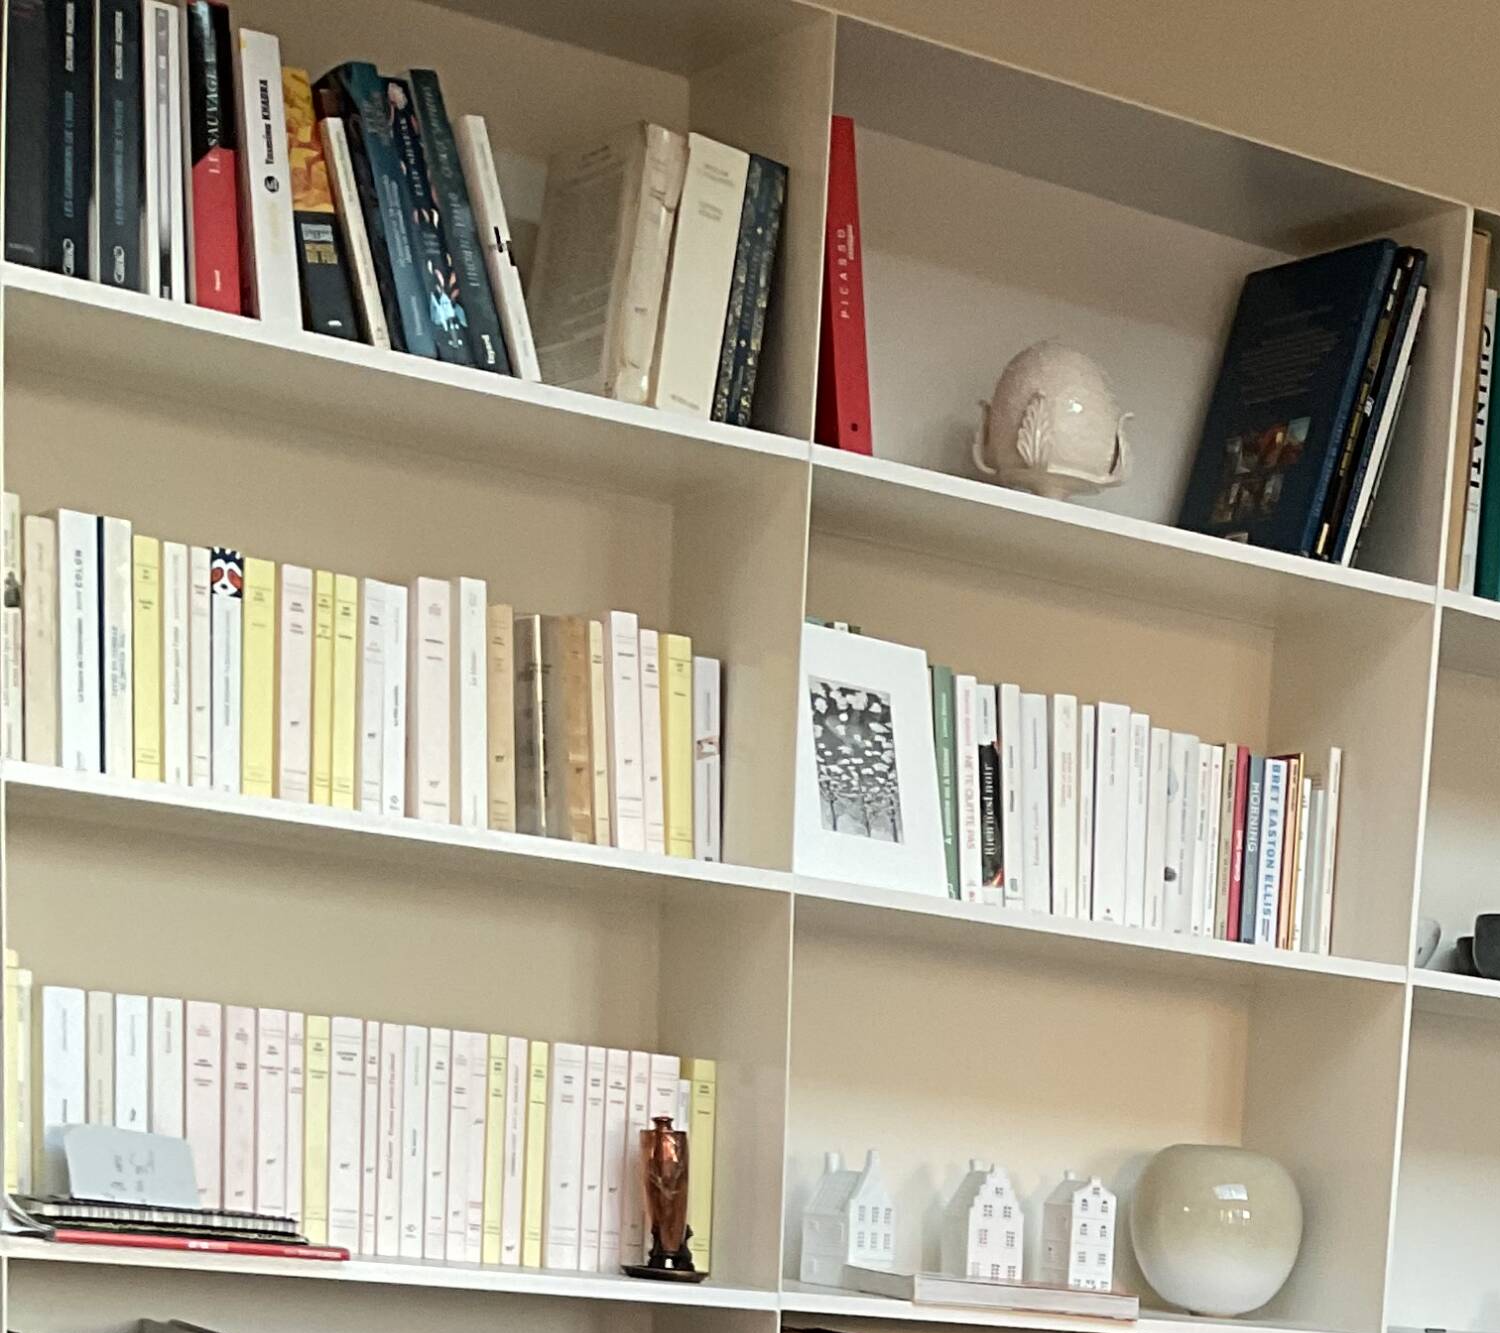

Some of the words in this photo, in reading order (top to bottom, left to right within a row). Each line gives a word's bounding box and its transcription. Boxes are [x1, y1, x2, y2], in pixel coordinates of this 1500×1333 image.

[259, 79, 271, 121] KHADRA
[837, 228, 850, 318] PICASSO
[1270, 764, 1282, 804] BRET
[1247, 782, 1261, 852] MORNING
[1265, 809, 1280, 869] EASTON
[1261, 874, 1274, 917] ELLIS
